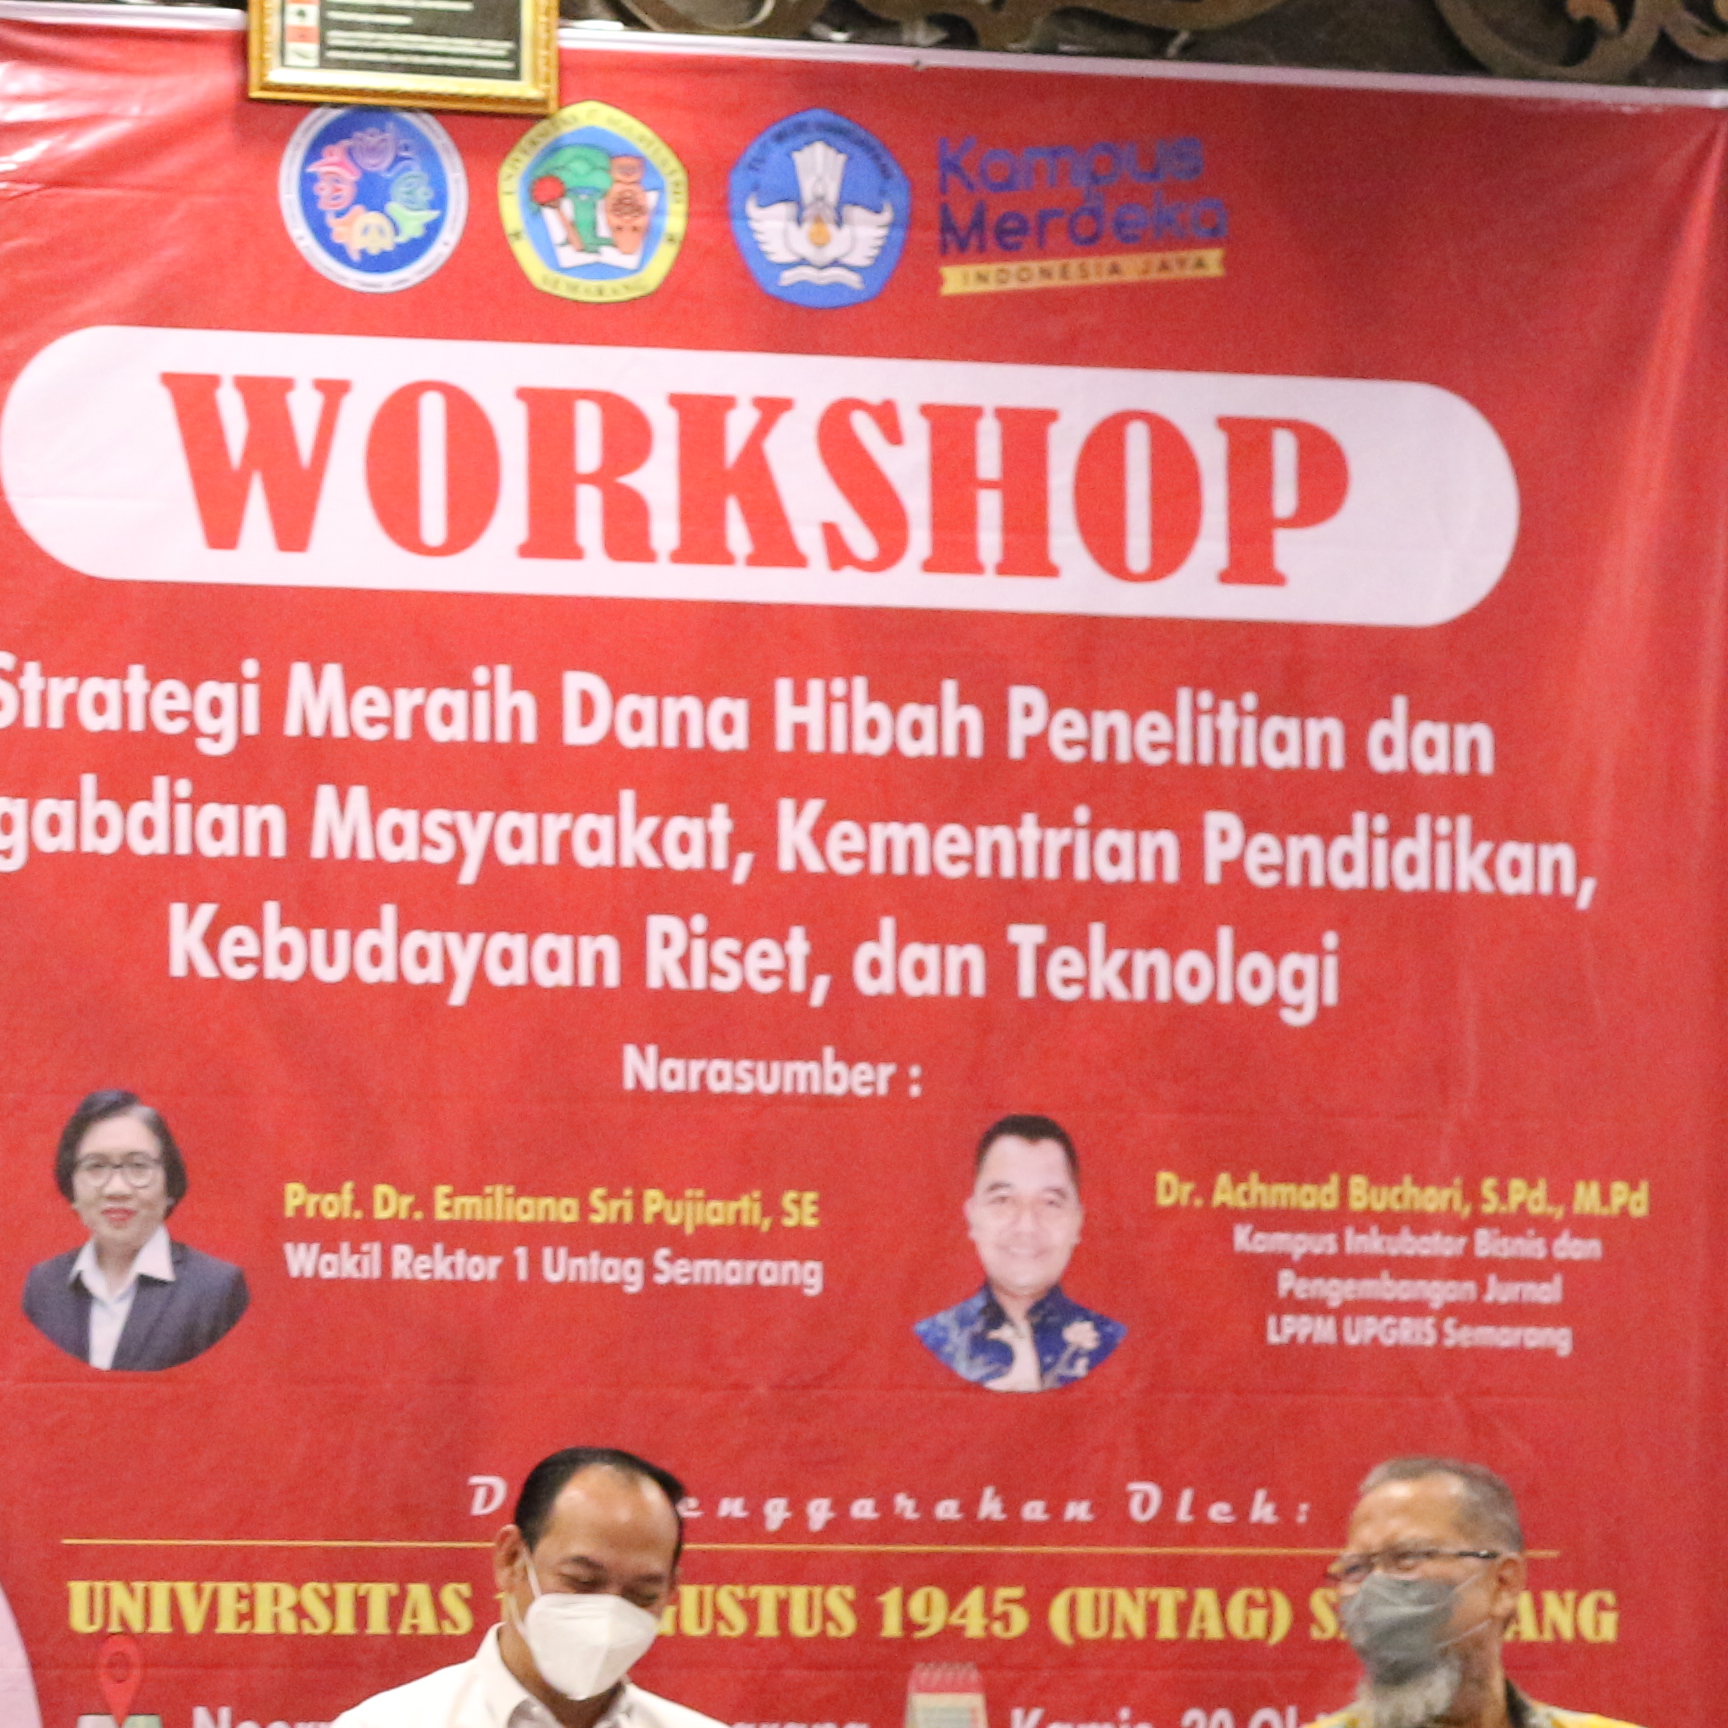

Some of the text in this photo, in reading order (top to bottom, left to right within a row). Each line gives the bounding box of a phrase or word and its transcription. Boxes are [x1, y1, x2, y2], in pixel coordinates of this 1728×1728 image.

[938, 135, 1205, 198] Kampus
[939, 190, 1229, 256] Merdeka
[962, 255, 1209, 287] INDONESIA JAYA
[162, 373, 1350, 586] WORKSHOP
[283, 661, 538, 744] Meraih
[562, 670, 750, 752] Dana
[774, 675, 983, 758] Hibah
[1008, 685, 1344, 770] Penelitian
[1367, 695, 1494, 775] dan
[310, 784, 754, 885] Masyarakat,
[777, 797, 1179, 883] Kementrian
[1204, 810, 1597, 910] Pendidikan,
[169, 900, 1339, 1027] Kebudayaan Riset, dan Teknologi
[623, 1043, 898, 1097] Narasumber
[284, 1180, 820, 1235] Prof. Dr. Emiliana Sri Pujiarti, SE
[1155, 1170, 1651, 1220] Dr. Achmad Buchori, S.Pd., M.Pd
[283, 1240, 825, 1297] Wakil Rektor 1 Untag Semarang
[1233, 1222, 1604, 1262] Kampus Inkubator Bisnis dan
[1276, 1268, 1564, 1311] Pengembangan Jurnal
[1266, 1313, 1574, 1358] LPPM UPGRIS Semarang
[1125, 1480, 1311, 1526] Oleh:
[66, 1580, 474, 1637] UNIVERSITAS
[877, 1585, 1031, 1640] 1945
[1047, 1586, 1294, 1646] (UNTAG)
